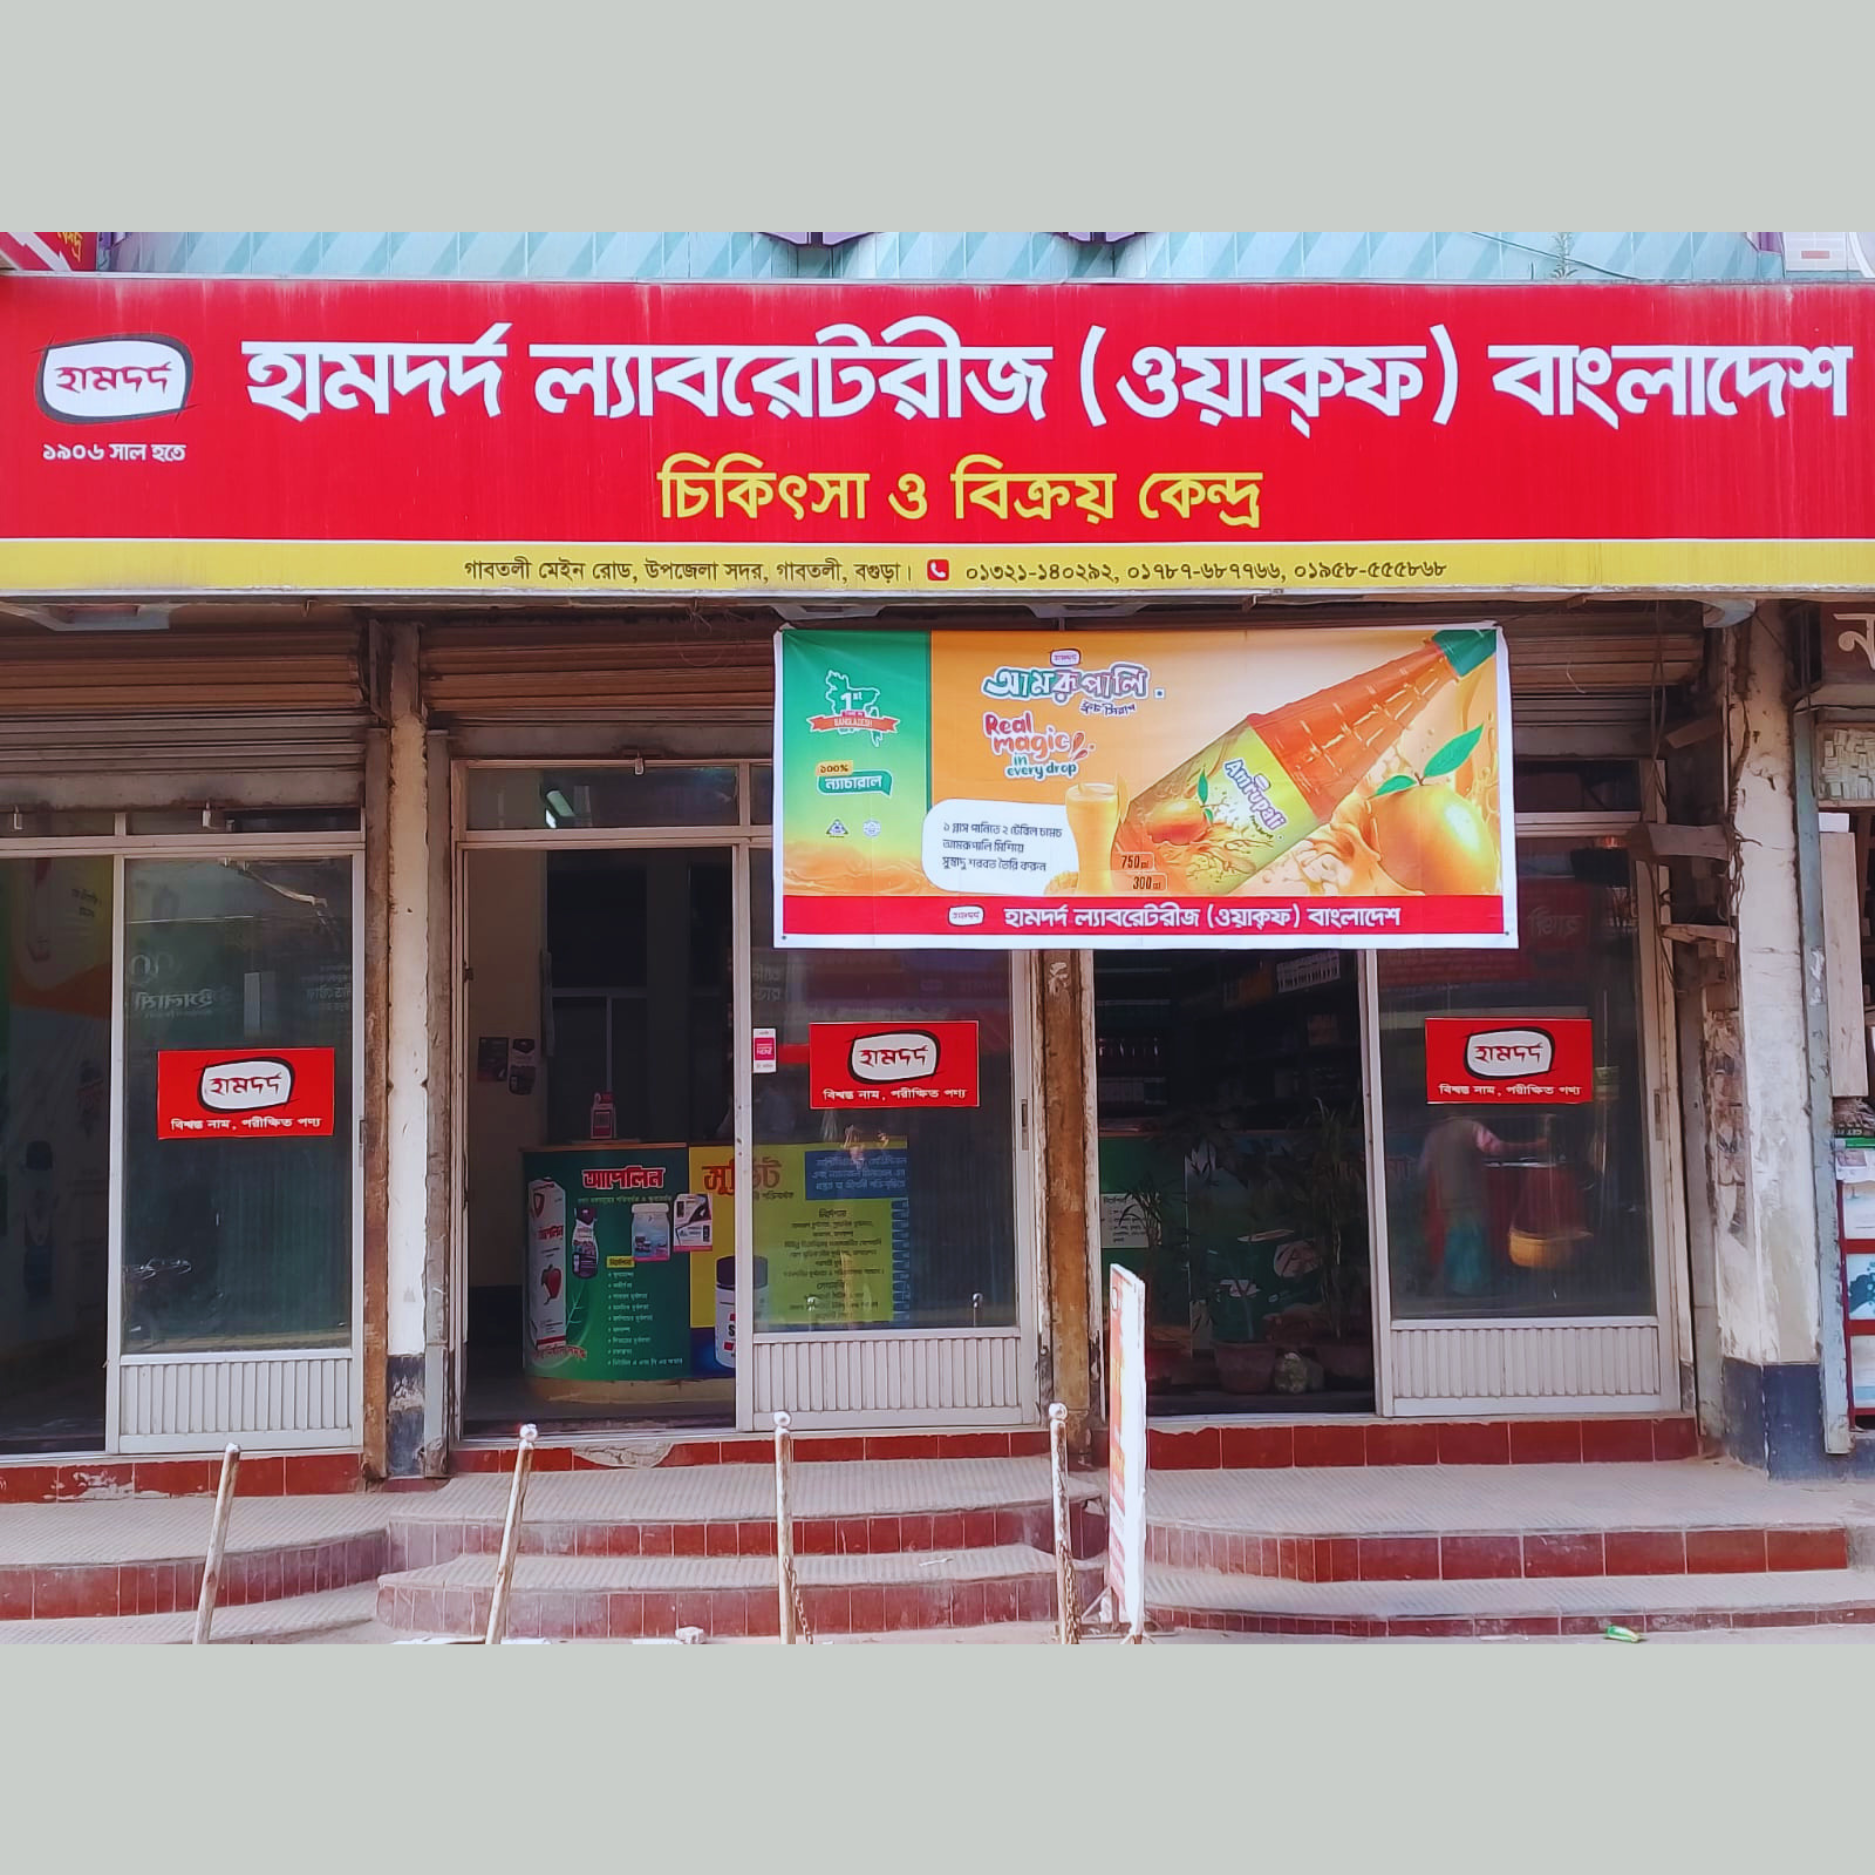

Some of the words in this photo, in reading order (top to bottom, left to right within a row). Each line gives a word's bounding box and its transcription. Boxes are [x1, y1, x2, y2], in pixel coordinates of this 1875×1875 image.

[53, 361, 173, 396] হামদর্দ
[242, 323, 511, 421] হামদর্দ
[530, 316, 1053, 420] ল্যাবরেটরীজ
[1488, 345, 1854, 430] বাংলাদেশ
[43, 444, 105, 462] ১৯০৬
[109, 443, 147, 462] সাল
[152, 443, 186, 463] হতে
[657, 452, 870, 520] চিকিৎসা
[889, 473, 928, 520] ও
[951, 454, 1117, 524] বিক্রয়
[1139, 472, 1264, 529] কেন্দ্র
[464, 556, 533, 580] গাবতলী
[539, 557, 586, 581] মেইন
[593, 562, 638, 583] রোড,
[644, 558, 718, 581] উপজেলা
[723, 563, 769, 584] সদর,
[777, 557, 848, 584] গাবতলী,
[966, 563, 1120, 584] ০১৩২১-১৪০২৯২,
[1127, 562, 1286, 585] ০১৭৮৭-৬৮৭৭৬৬,
[1294, 561, 1447, 580] ০১৯৫৮-৫৫৫৮৬৮
[985, 711, 1033, 736] Real
[993, 727, 1071, 759] magic
[820, 763, 849, 774] ১০০%
[1007, 765, 1044, 779] every
[1045, 761, 1078, 777] drop
[1013, 752, 1028, 766] in
[1223, 758, 1287, 831] Amrupali
[1003, 904, 1069, 929] হামদর্দ
[1073, 901, 1201, 928] ল্যাবরেটরীজ
[1306, 904, 1401, 928] বাংলাদেশ
[857, 1045, 930, 1069] হামদর্দ
[1472, 1042, 1545, 1064] হামদর্দ
[208, 1071, 283, 1097] হামদর্দ
